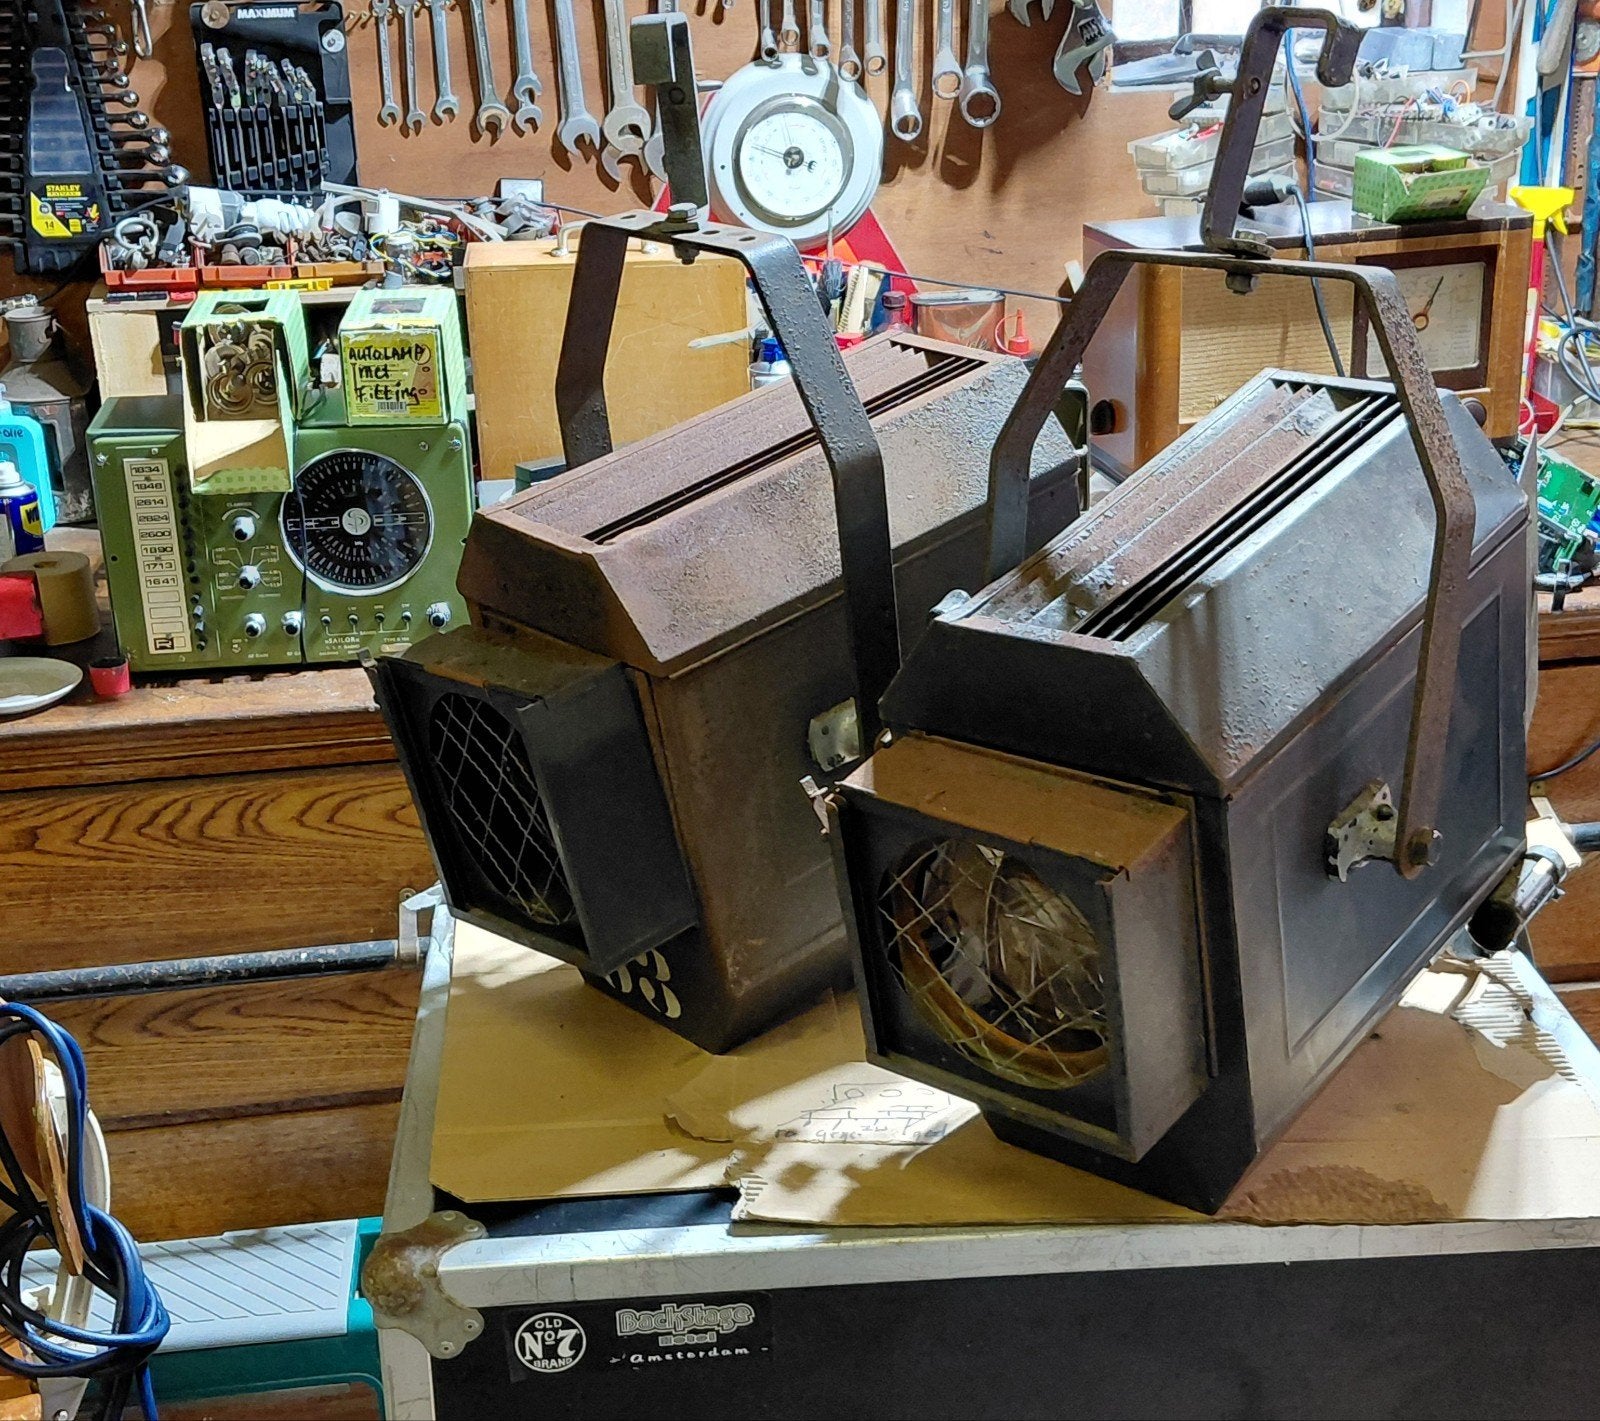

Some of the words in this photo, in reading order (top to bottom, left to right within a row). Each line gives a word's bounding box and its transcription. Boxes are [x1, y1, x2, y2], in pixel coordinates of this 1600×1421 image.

[237, 8, 295, 19] MAXIMUM
[46, 184, 81, 192] STANLEY
[44, 221, 55, 229] 14
[349, 343, 425, 361] AUTOLAMP
[136, 498, 164, 506] 2614
[140, 530, 171, 538] 2600
[145, 561, 173, 570] 1713
[146, 577, 176, 585] 1641
[534, 1317, 563, 1329] OLD
[533, 1358, 573, 1369] BRAND
